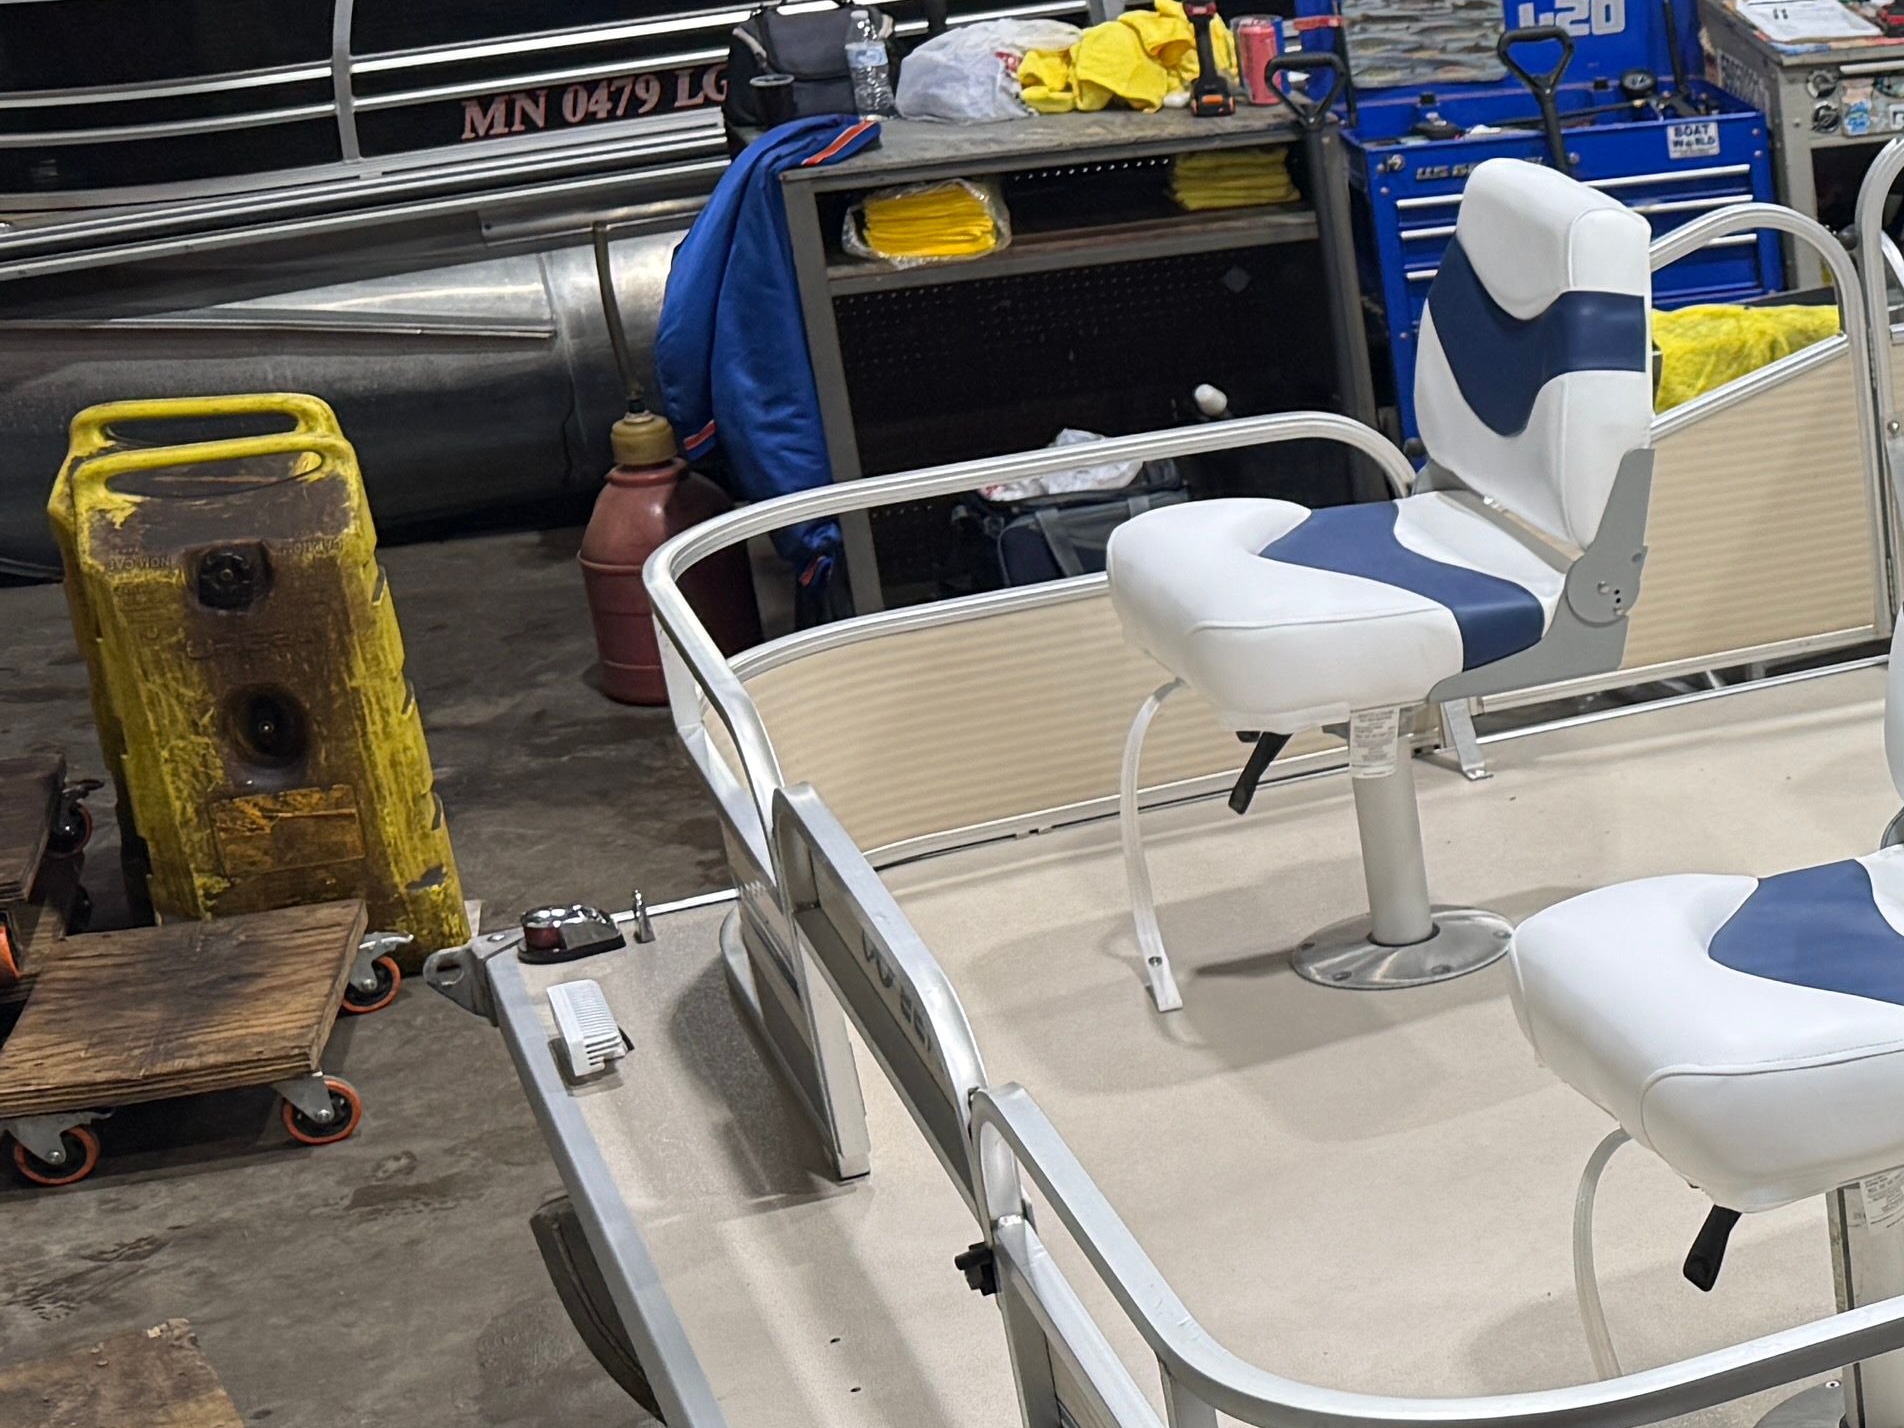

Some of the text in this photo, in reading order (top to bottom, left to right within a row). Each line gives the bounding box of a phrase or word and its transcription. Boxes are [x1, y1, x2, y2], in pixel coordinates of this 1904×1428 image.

[461, 90, 549, 140] MN
[562, 73, 662, 124] 0479
[1674, 124, 1709, 137] BOAT
